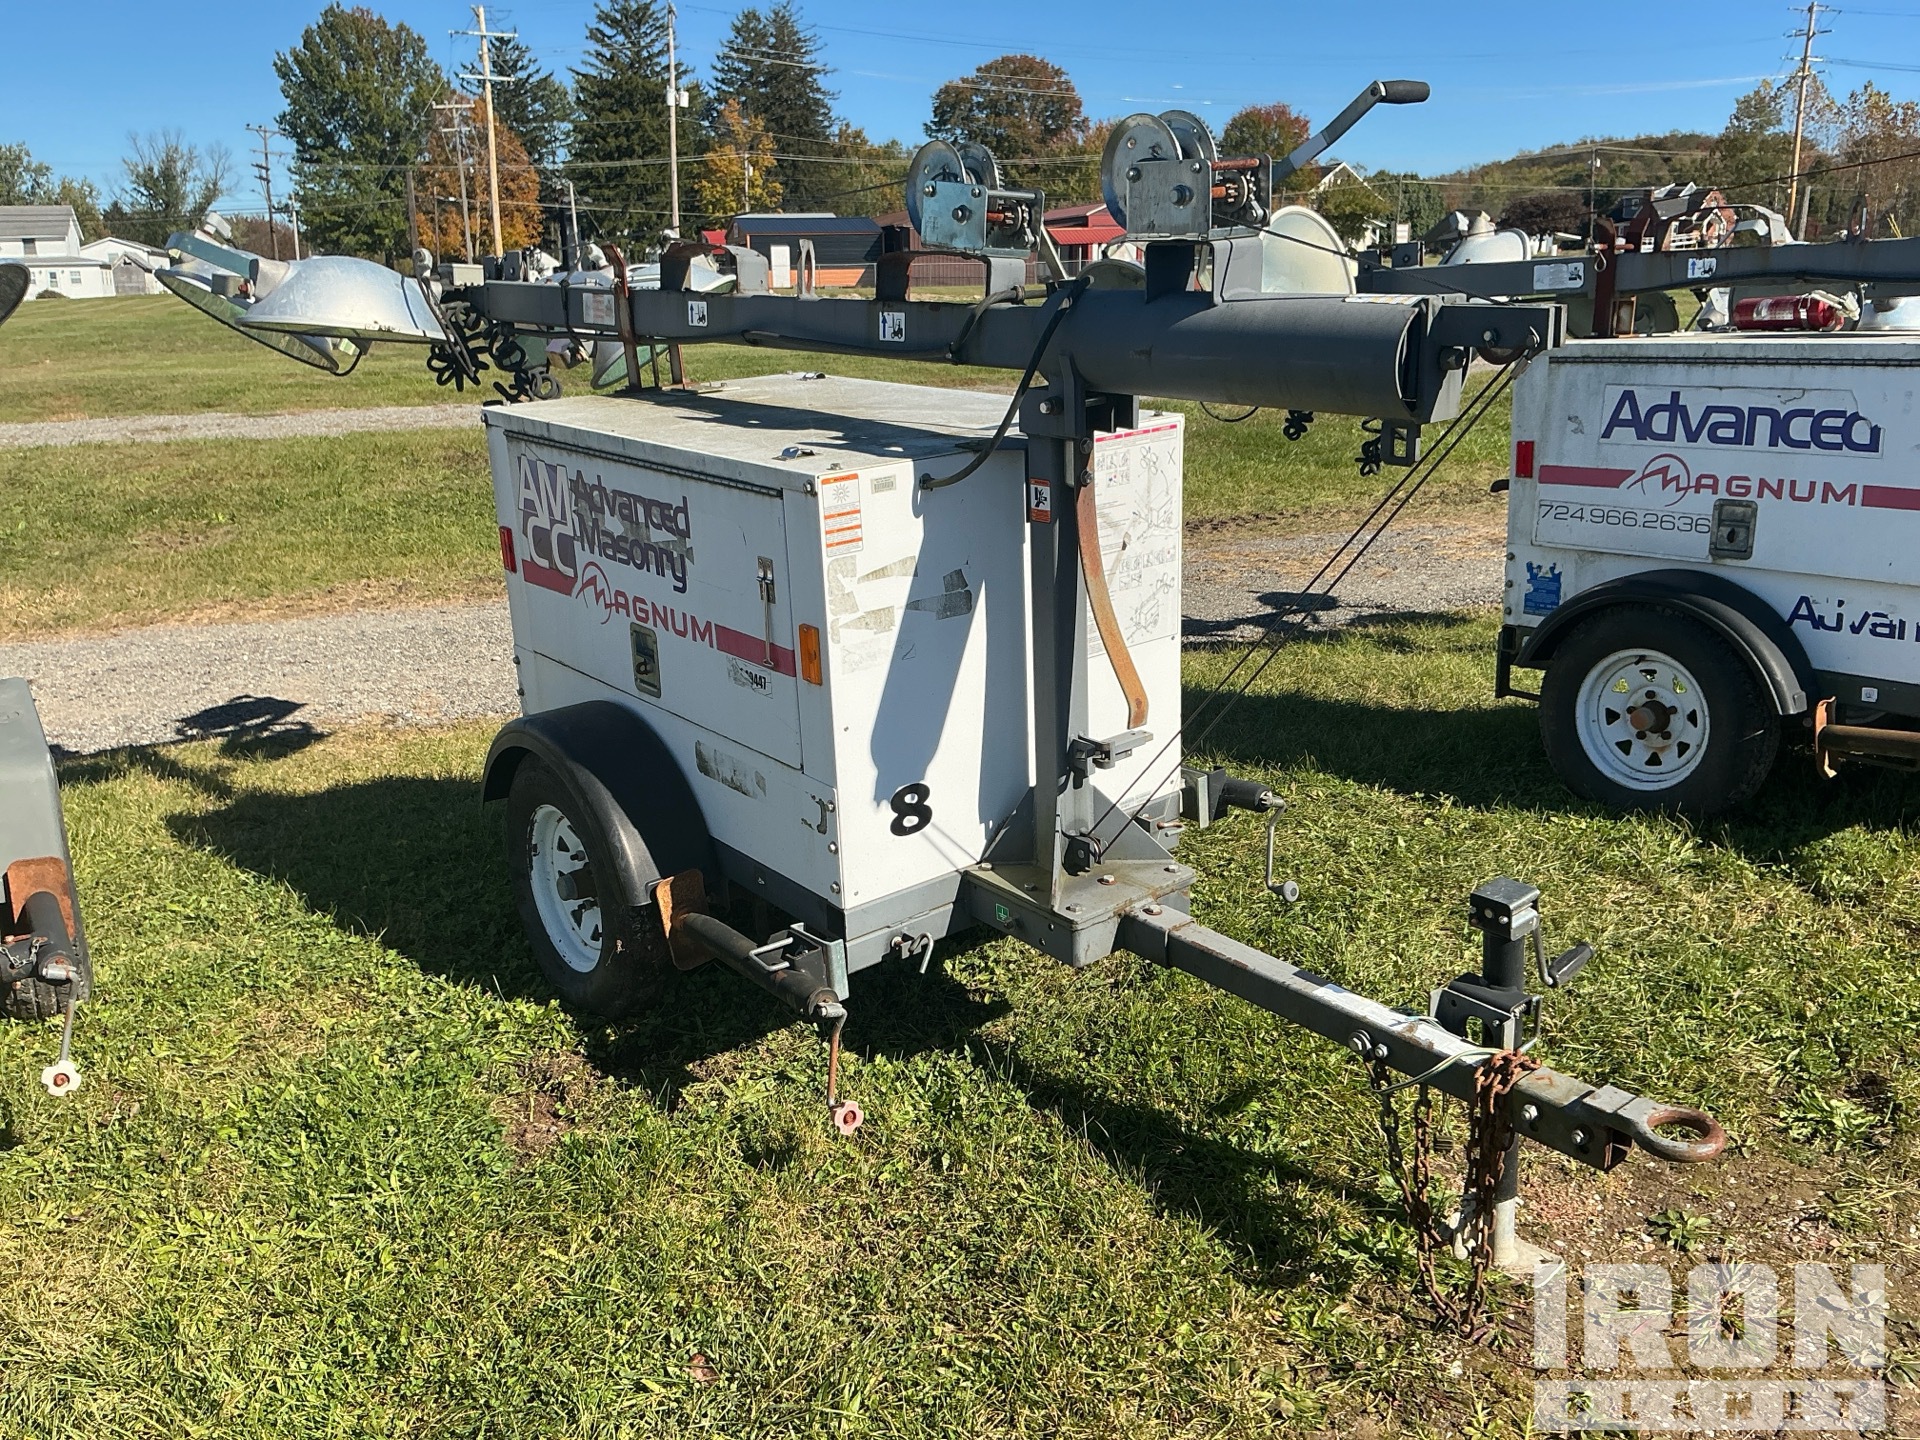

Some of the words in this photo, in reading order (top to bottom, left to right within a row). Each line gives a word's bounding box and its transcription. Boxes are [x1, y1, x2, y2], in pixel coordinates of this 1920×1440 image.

[572, 470, 691, 540] Advanced
[1627, 454, 1857, 507] MAGNUM
[1539, 503, 1711, 535] 724.966.2636
[577, 510, 688, 594] Masonry
[576, 561, 715, 649] MAGNUM
[890, 782, 932, 837] 8
